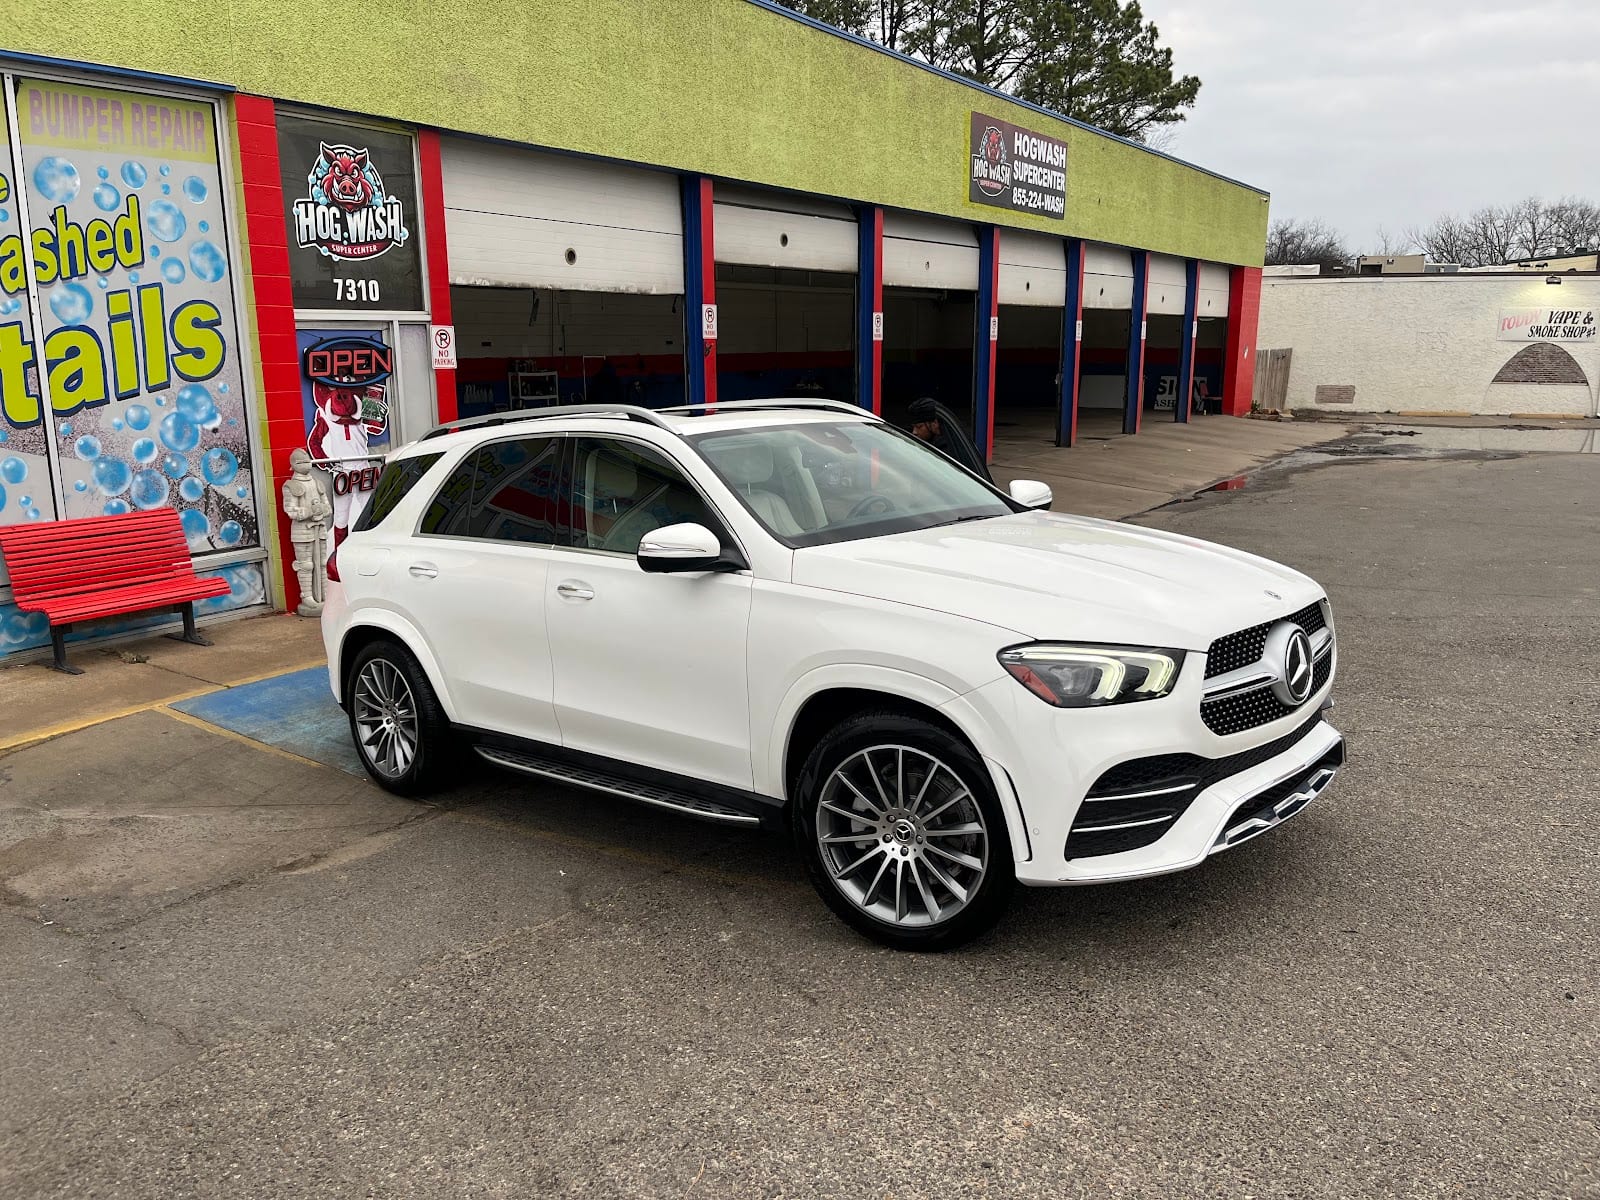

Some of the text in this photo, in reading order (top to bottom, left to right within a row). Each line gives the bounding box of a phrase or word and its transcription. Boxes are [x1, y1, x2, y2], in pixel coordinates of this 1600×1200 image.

[27, 88, 208, 154] BUMPER REPAIR
[1014, 132, 1066, 169] HOGWASH
[973, 158, 1011, 186] HOG WASH
[1013, 160, 1065, 191] SUPERCENTER
[1012, 187, 1064, 213] 855-224-WASH
[297, 203, 401, 243] HOG WASH
[331, 244, 377, 254] SUPER CENTER
[332, 277, 381, 302] 7310
[1527, 325, 1561, 338] SMOKE
[1548, 310, 1582, 325] VAPE
[1583, 311, 1594, 325] &
[308, 348, 393, 378] OPEN
